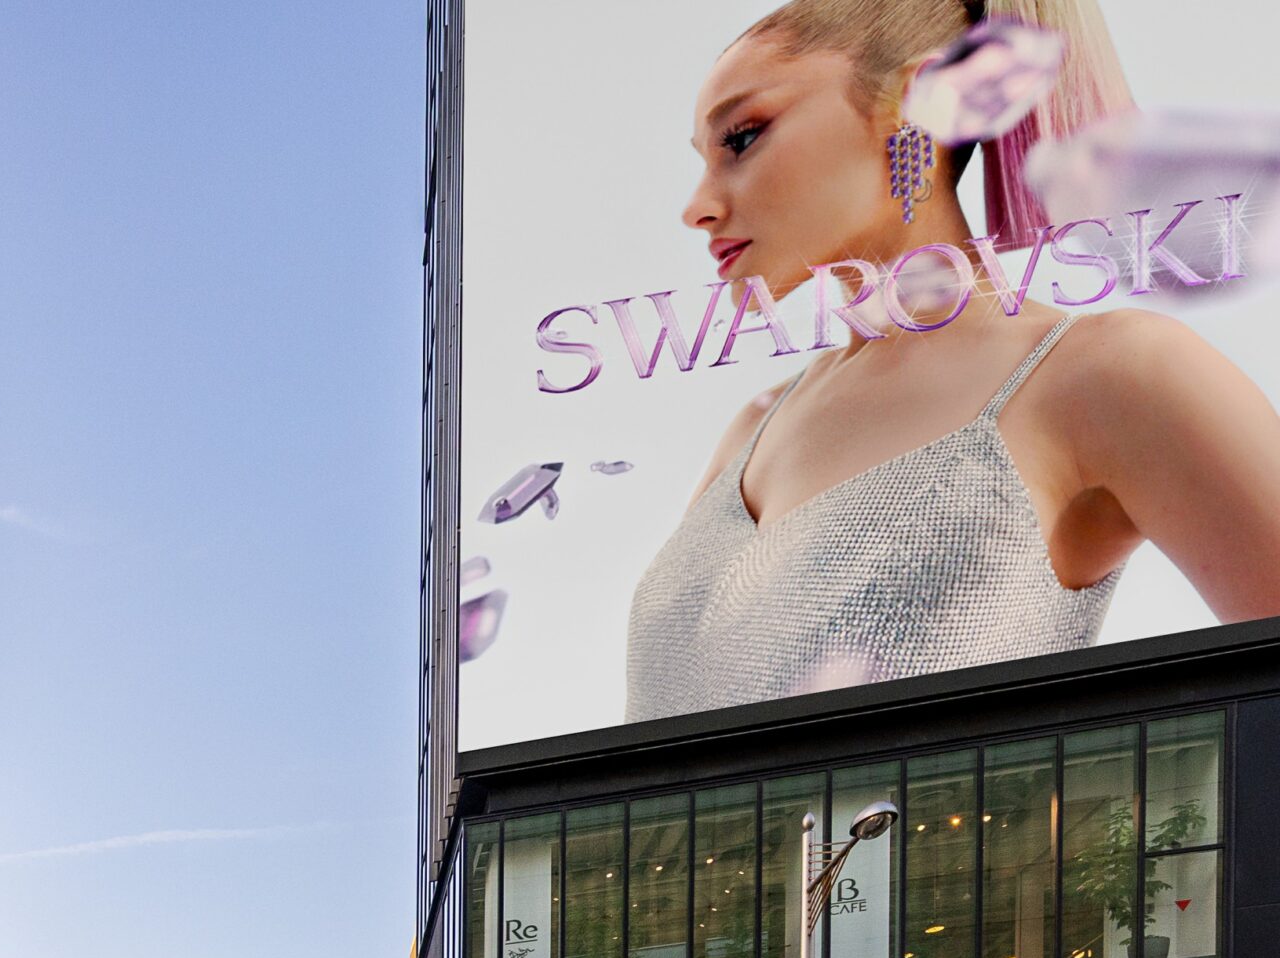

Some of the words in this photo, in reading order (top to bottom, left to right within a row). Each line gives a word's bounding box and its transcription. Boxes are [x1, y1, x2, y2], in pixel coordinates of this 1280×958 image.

[535, 193, 1248, 395] SWAROVSKI
[831, 901, 867, 916] CAFE
[505, 919, 538, 942] Re
